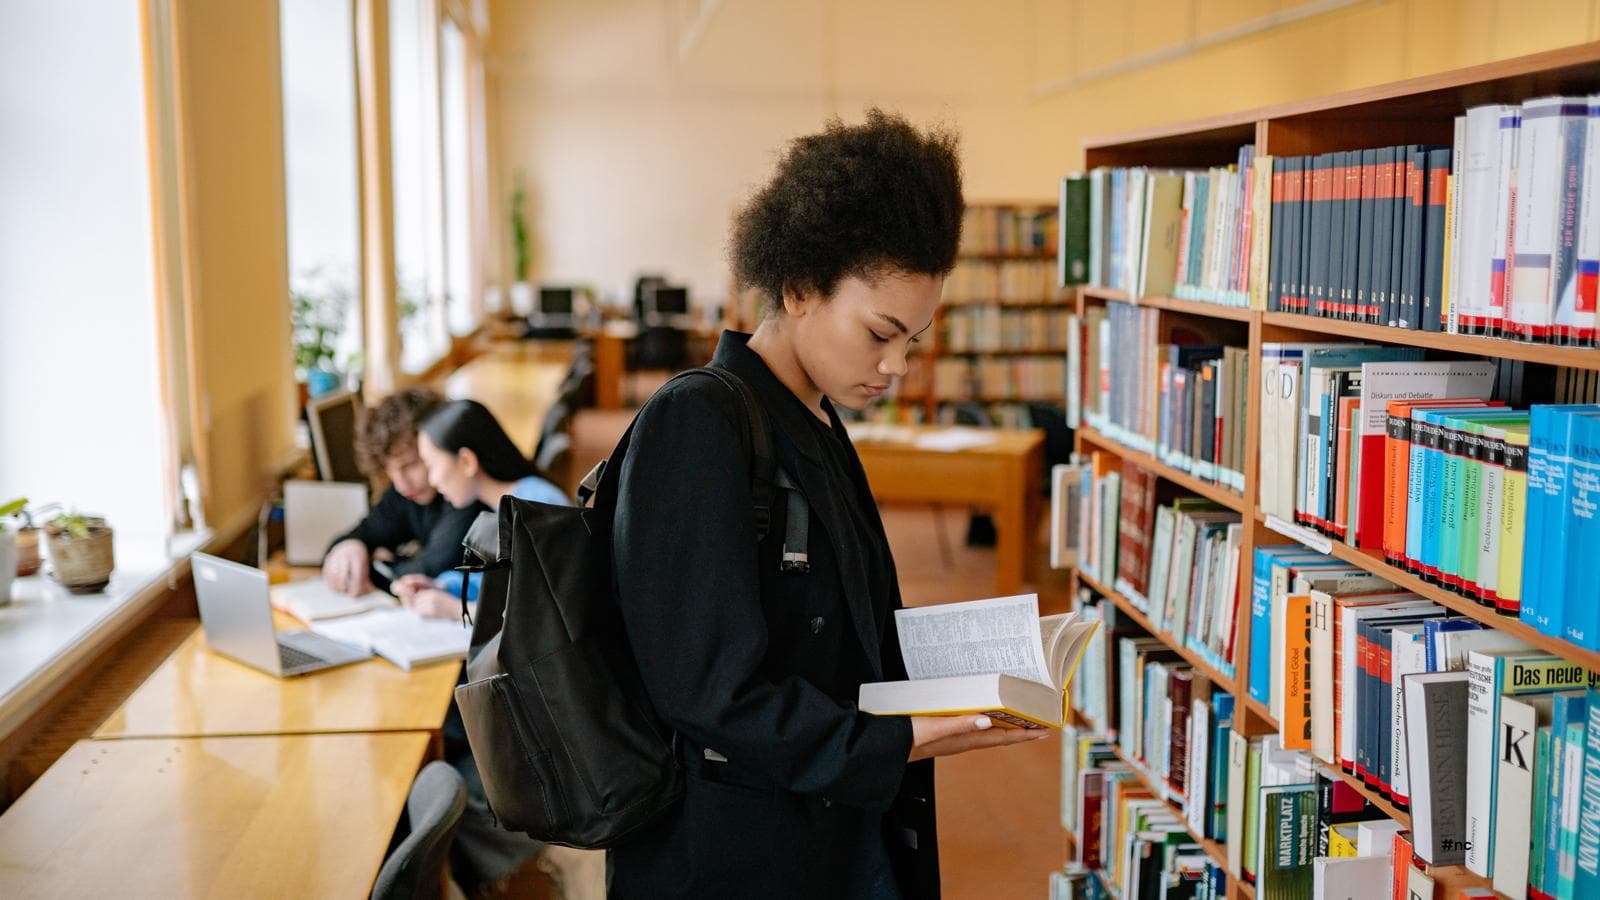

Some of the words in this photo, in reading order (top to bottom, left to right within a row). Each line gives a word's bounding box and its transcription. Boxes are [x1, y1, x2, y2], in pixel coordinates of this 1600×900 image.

[1266, 369, 1275, 396] C
[1282, 373, 1293, 399] D
[1371, 391, 1393, 400] Diskurs
[1394, 392, 1407, 400] und
[1408, 391, 1433, 400] Debatte
[1448, 503, 1456, 529] gutes
[1483, 471, 1495, 553] Redewendungen
[1276, 575, 1282, 596] F
[1314, 601, 1327, 632] H
[1513, 665, 1541, 686] Das
[1546, 667, 1583, 685] neue
[1587, 704, 1600, 752] DER
[1394, 728, 1402, 778] Grammatik
[1502, 722, 1530, 772] K
[1578, 753, 1600, 877] KAUFMANN
[1279, 797, 1294, 867] MARKTPLATZ
